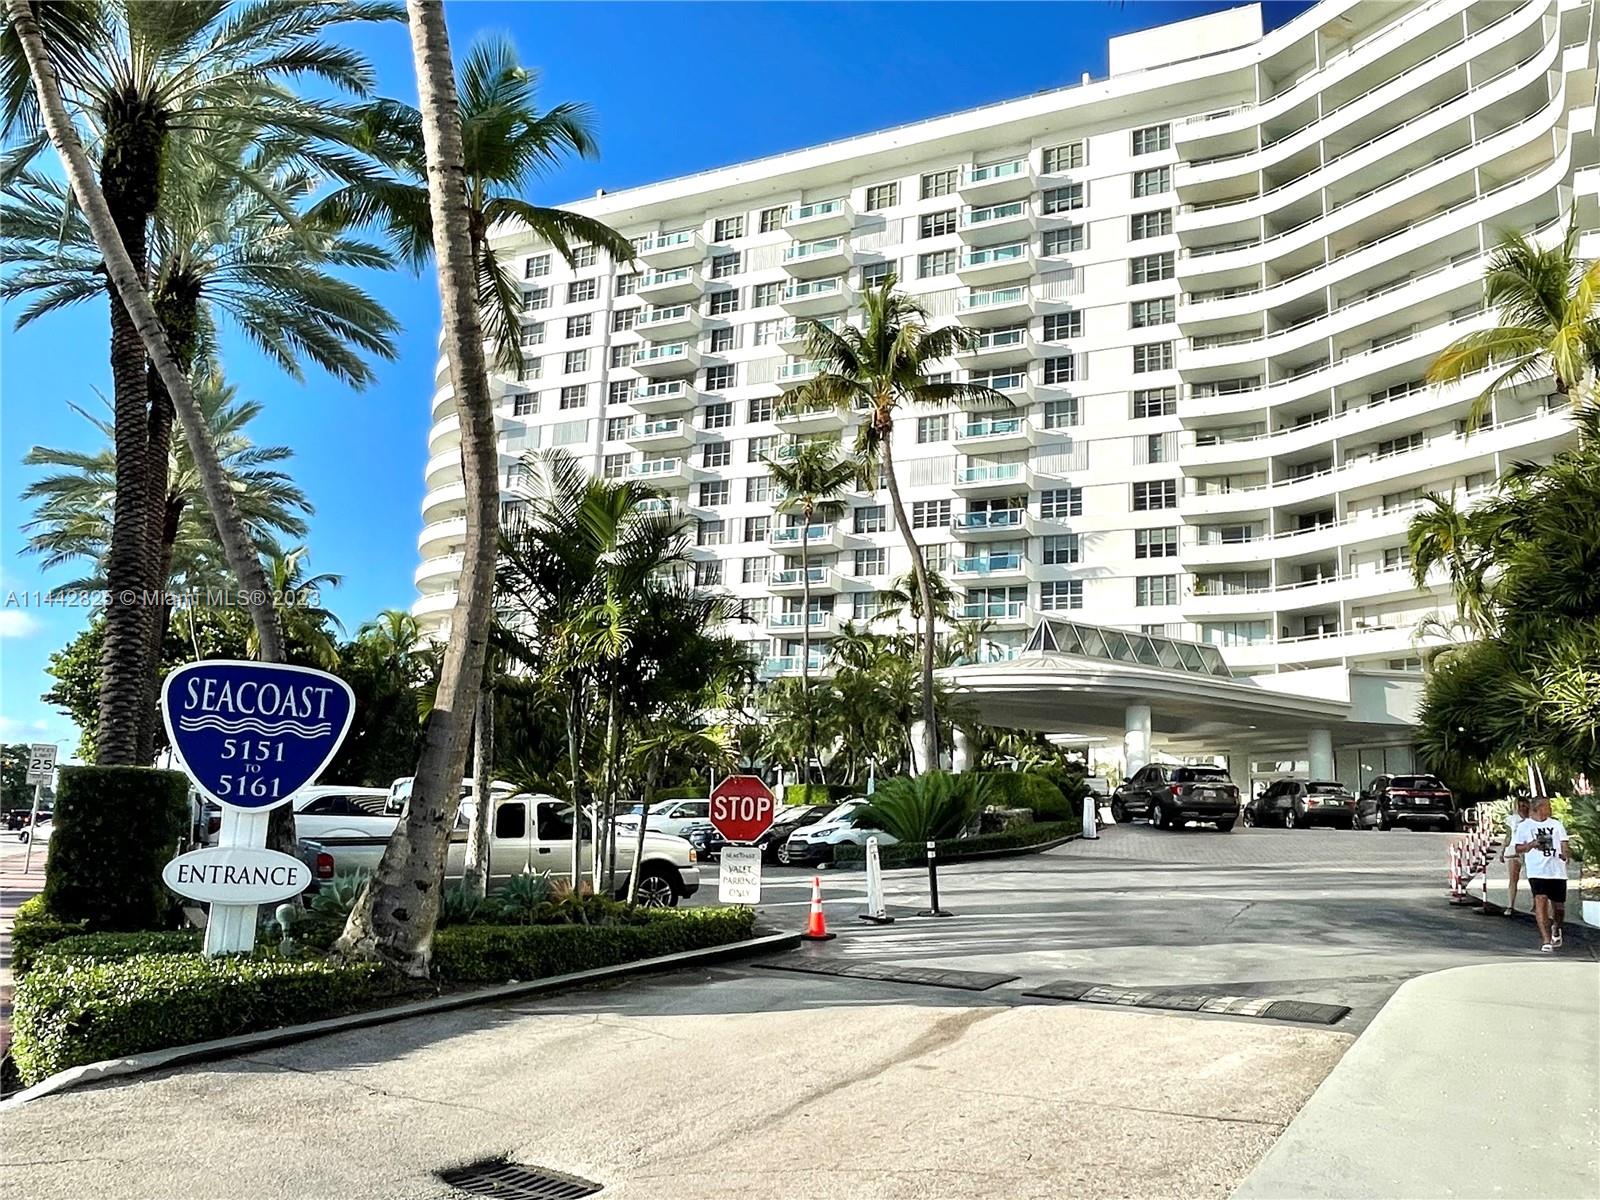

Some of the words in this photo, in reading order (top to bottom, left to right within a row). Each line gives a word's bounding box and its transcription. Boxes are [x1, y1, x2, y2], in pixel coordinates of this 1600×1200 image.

[184, 677, 333, 719] SEACOAST
[221, 739, 285, 762] 5151
[31, 759, 52, 770] 25
[245, 763, 261, 774] TO
[217, 775, 281, 798] 5161
[714, 796, 771, 821] STOP
[177, 864, 298, 886] ENTRANCE
[728, 865, 752, 874] VALET
[722, 876, 758, 886] PARKING
